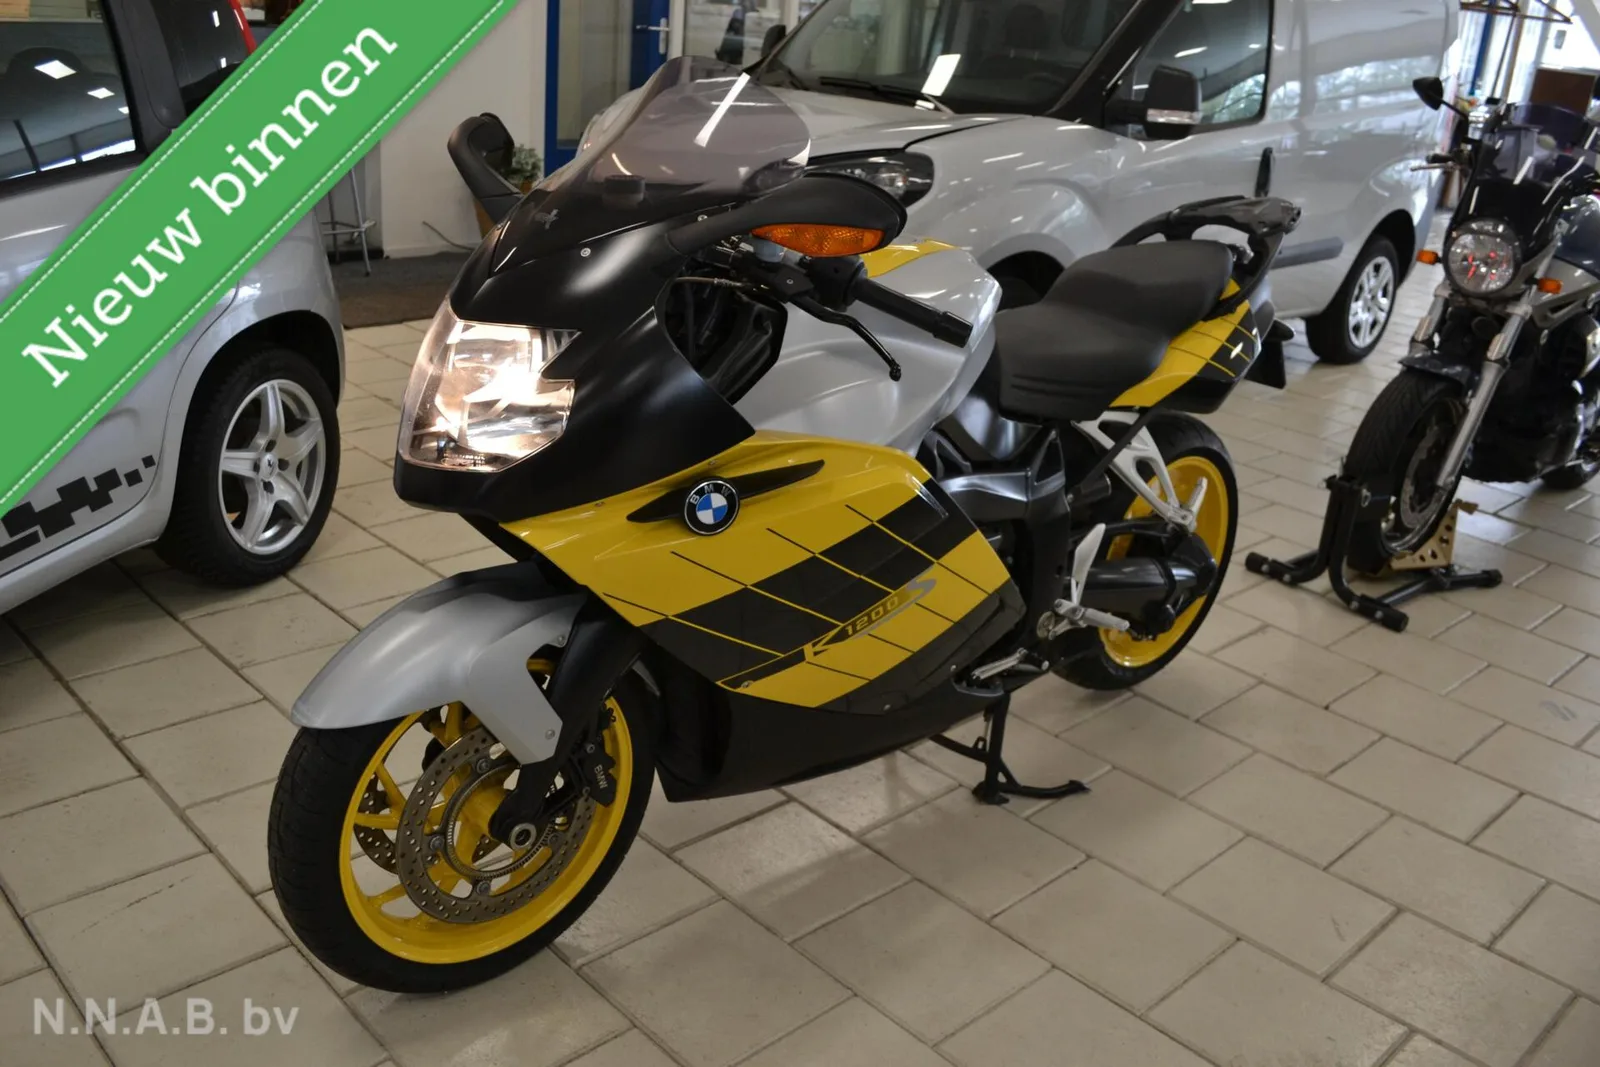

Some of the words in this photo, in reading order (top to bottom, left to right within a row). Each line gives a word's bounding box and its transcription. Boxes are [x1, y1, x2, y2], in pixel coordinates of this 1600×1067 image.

[689, 483, 731, 505] BMW
[845, 596, 898, 635] 1200
[594, 764, 608, 789] BMW
